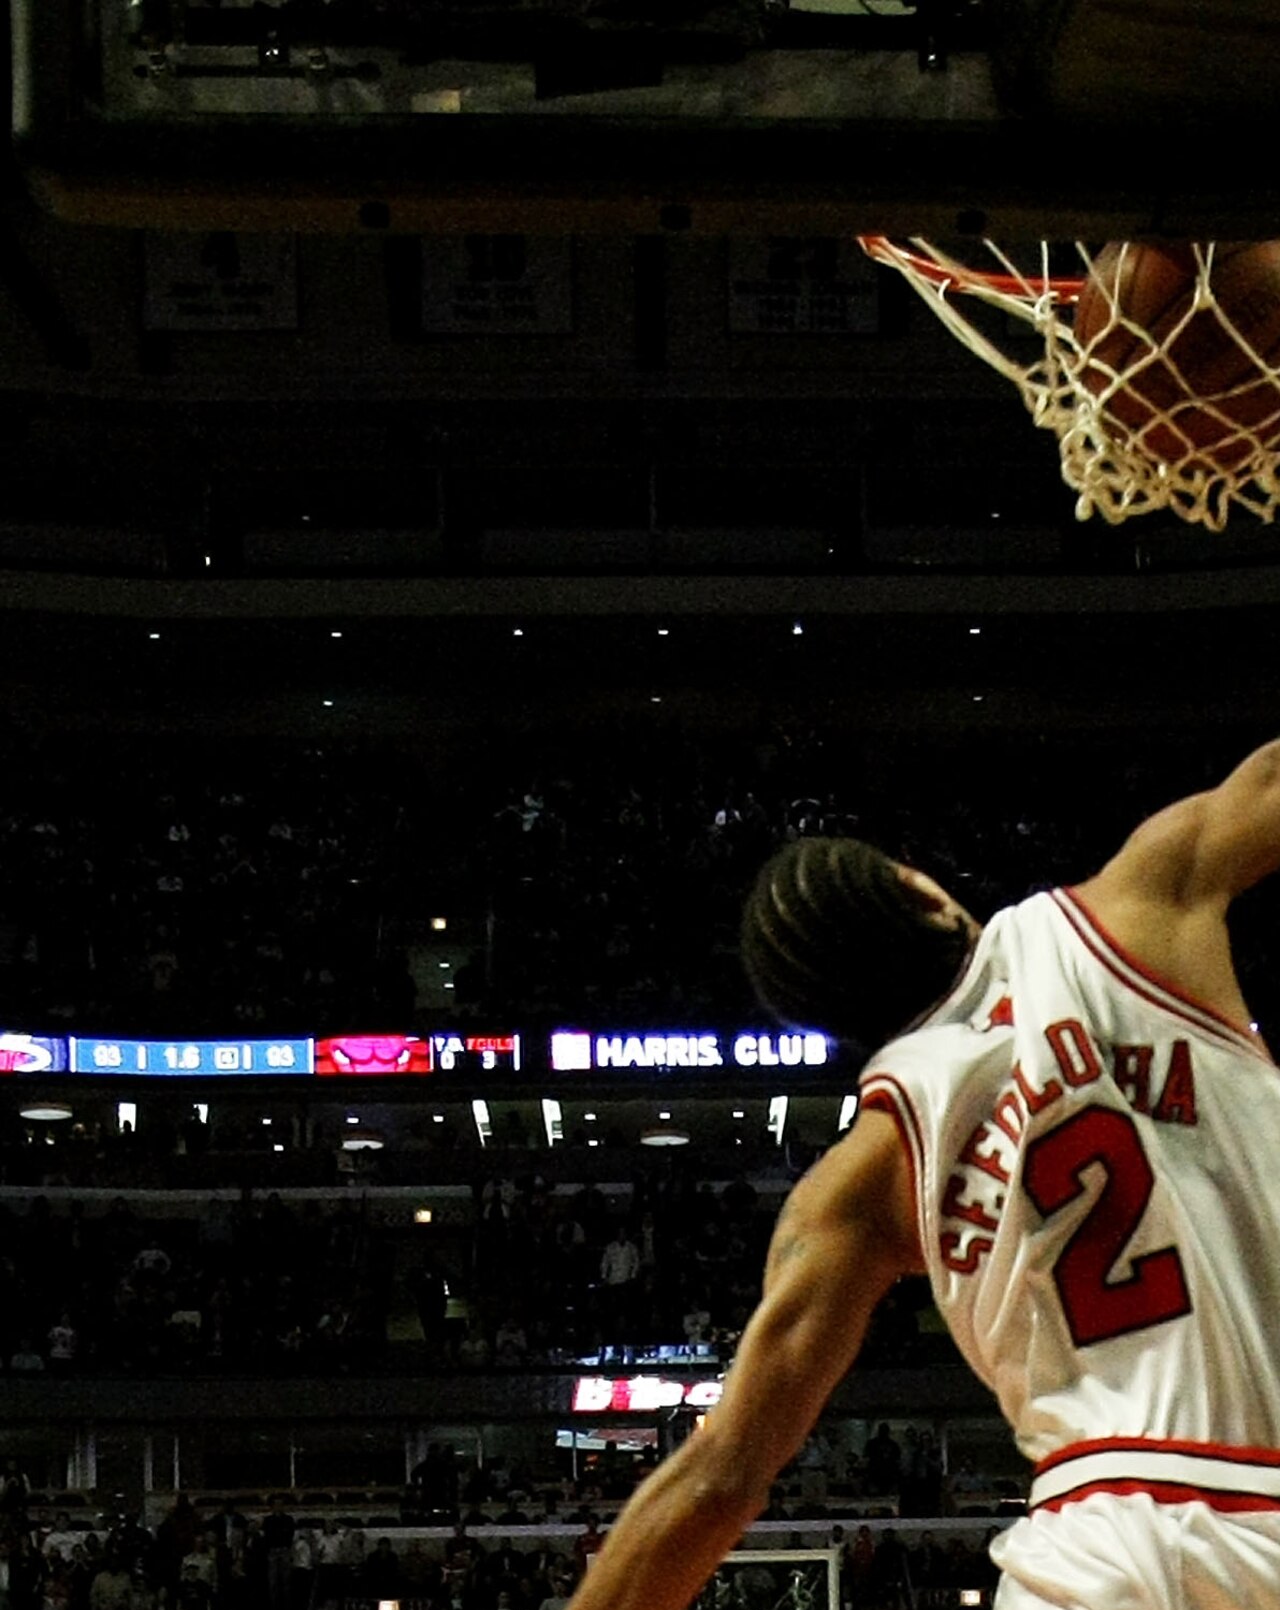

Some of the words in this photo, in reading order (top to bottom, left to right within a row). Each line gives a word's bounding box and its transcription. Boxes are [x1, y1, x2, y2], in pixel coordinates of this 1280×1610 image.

[734, 1035, 827, 1066] CLUB
[940, 1018, 1198, 1275] SEFOLOHA
[1022, 1104, 1194, 1349] 2
